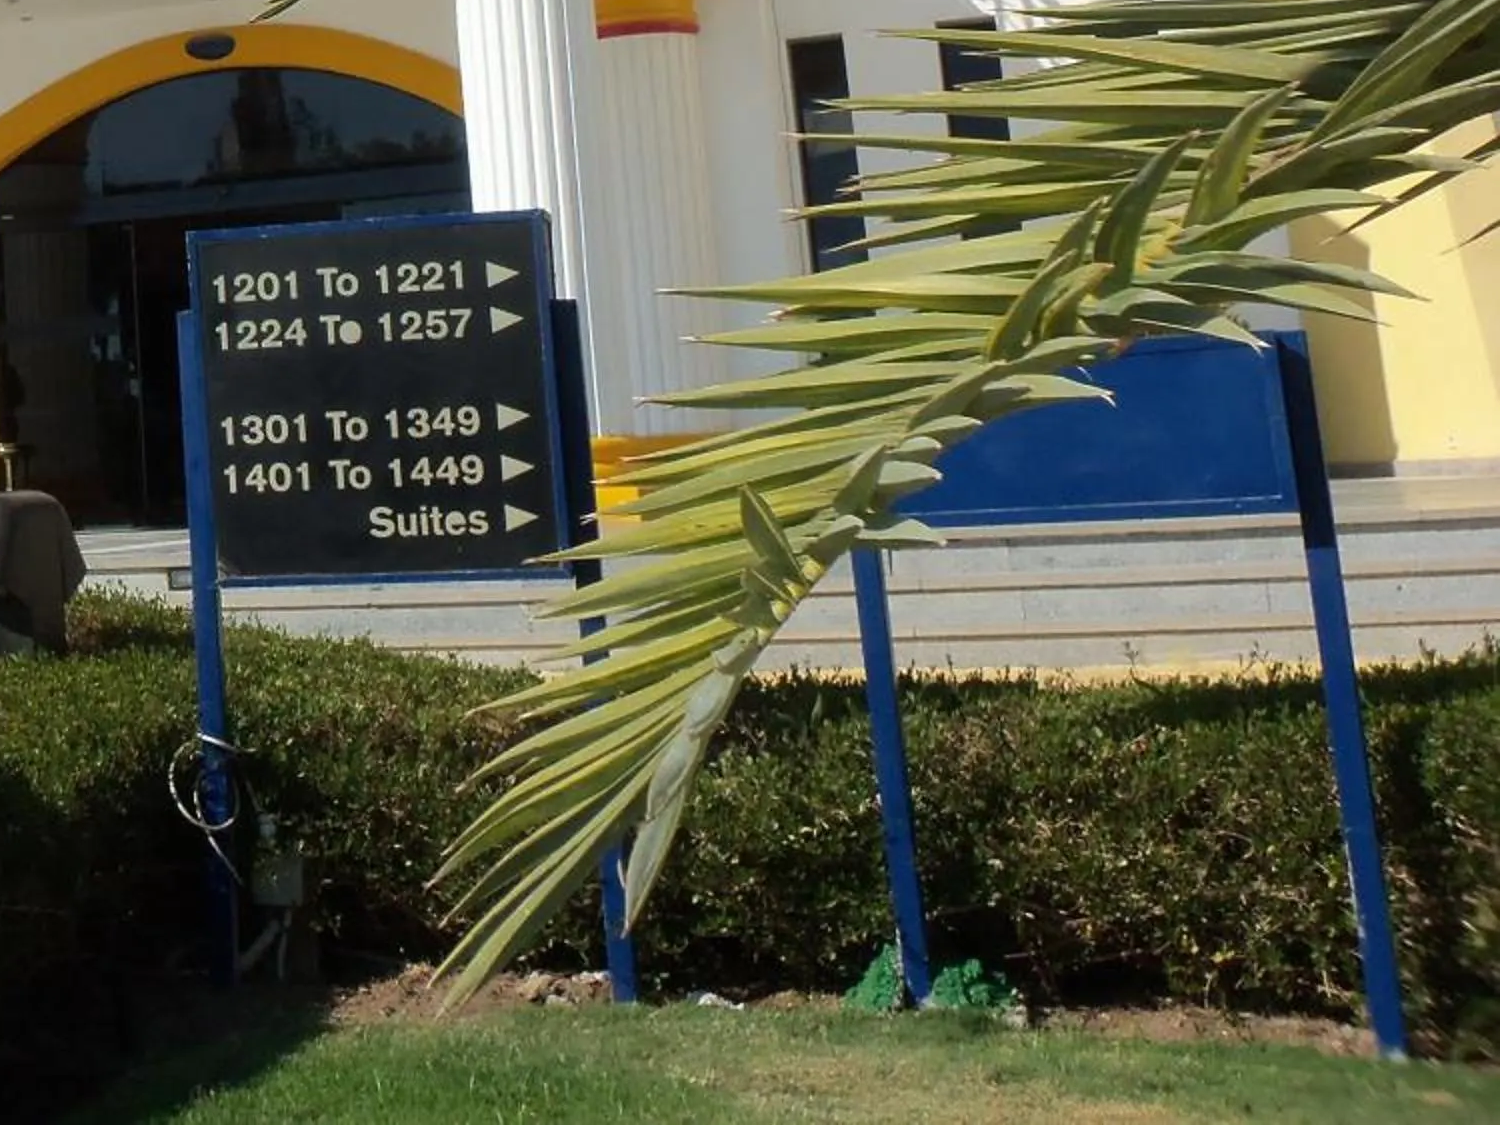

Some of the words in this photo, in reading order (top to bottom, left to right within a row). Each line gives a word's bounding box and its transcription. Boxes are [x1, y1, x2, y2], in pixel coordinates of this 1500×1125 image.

[212, 270, 298, 304] 1201
[315, 266, 359, 298] To
[375, 260, 464, 294] 1221
[215, 317, 308, 351] 1224
[318, 314, 362, 345] To
[377, 308, 473, 342] 1257
[220, 413, 307, 446] 1301
[324, 410, 369, 442] To
[384, 405, 481, 439] 1349
[223, 461, 310, 494] 1401
[327, 459, 372, 490] To
[388, 454, 485, 488] 1449
[368, 506, 489, 538] Suites
